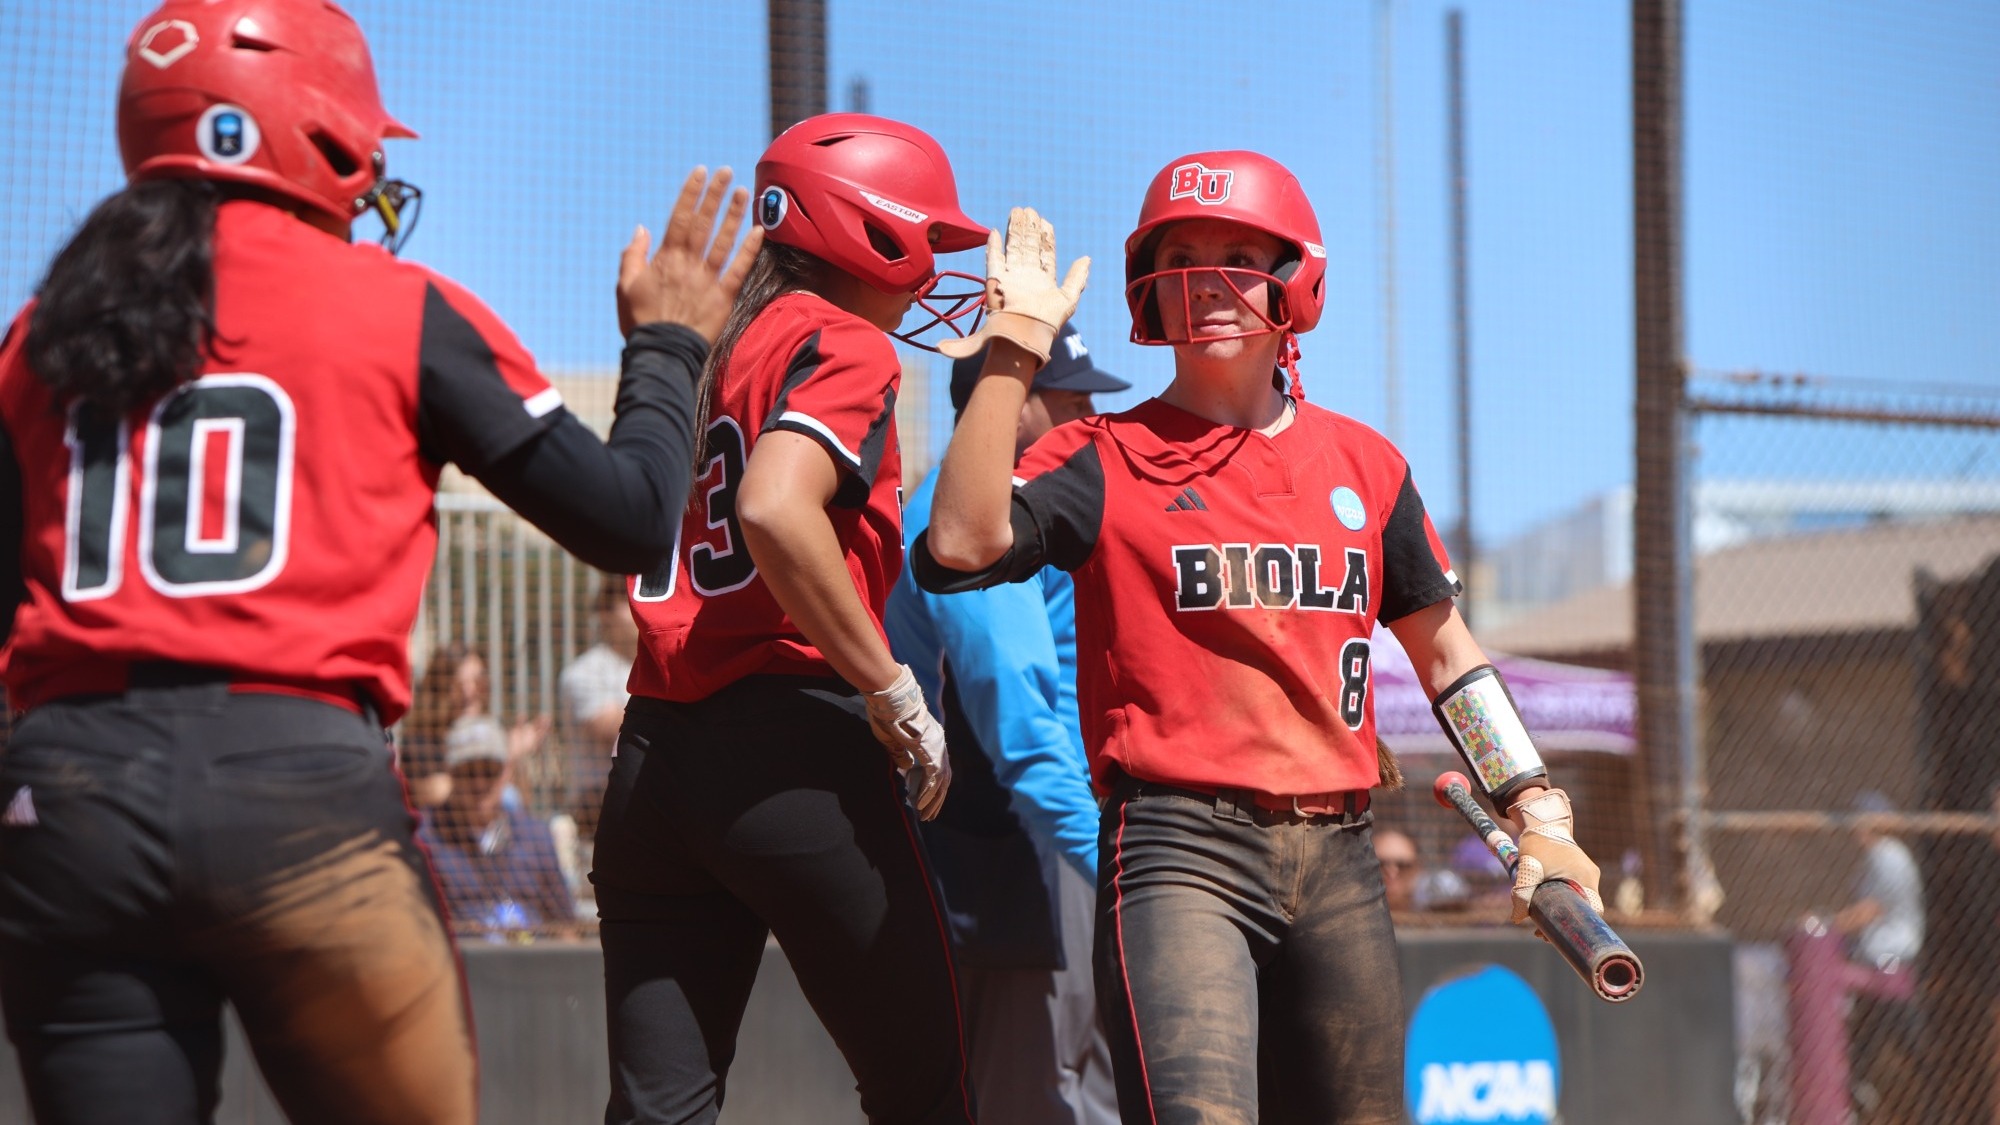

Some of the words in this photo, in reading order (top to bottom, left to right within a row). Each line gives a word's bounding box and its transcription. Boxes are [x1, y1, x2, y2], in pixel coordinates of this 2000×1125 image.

[876, 199, 920, 219] EASTON
[1170, 162, 1234, 205] BU
[62, 373, 296, 602] 10
[1171, 543, 1369, 616] BIOLA
[1339, 637, 1371, 731] 8
[1416, 1059, 1557, 1124] NCAA
